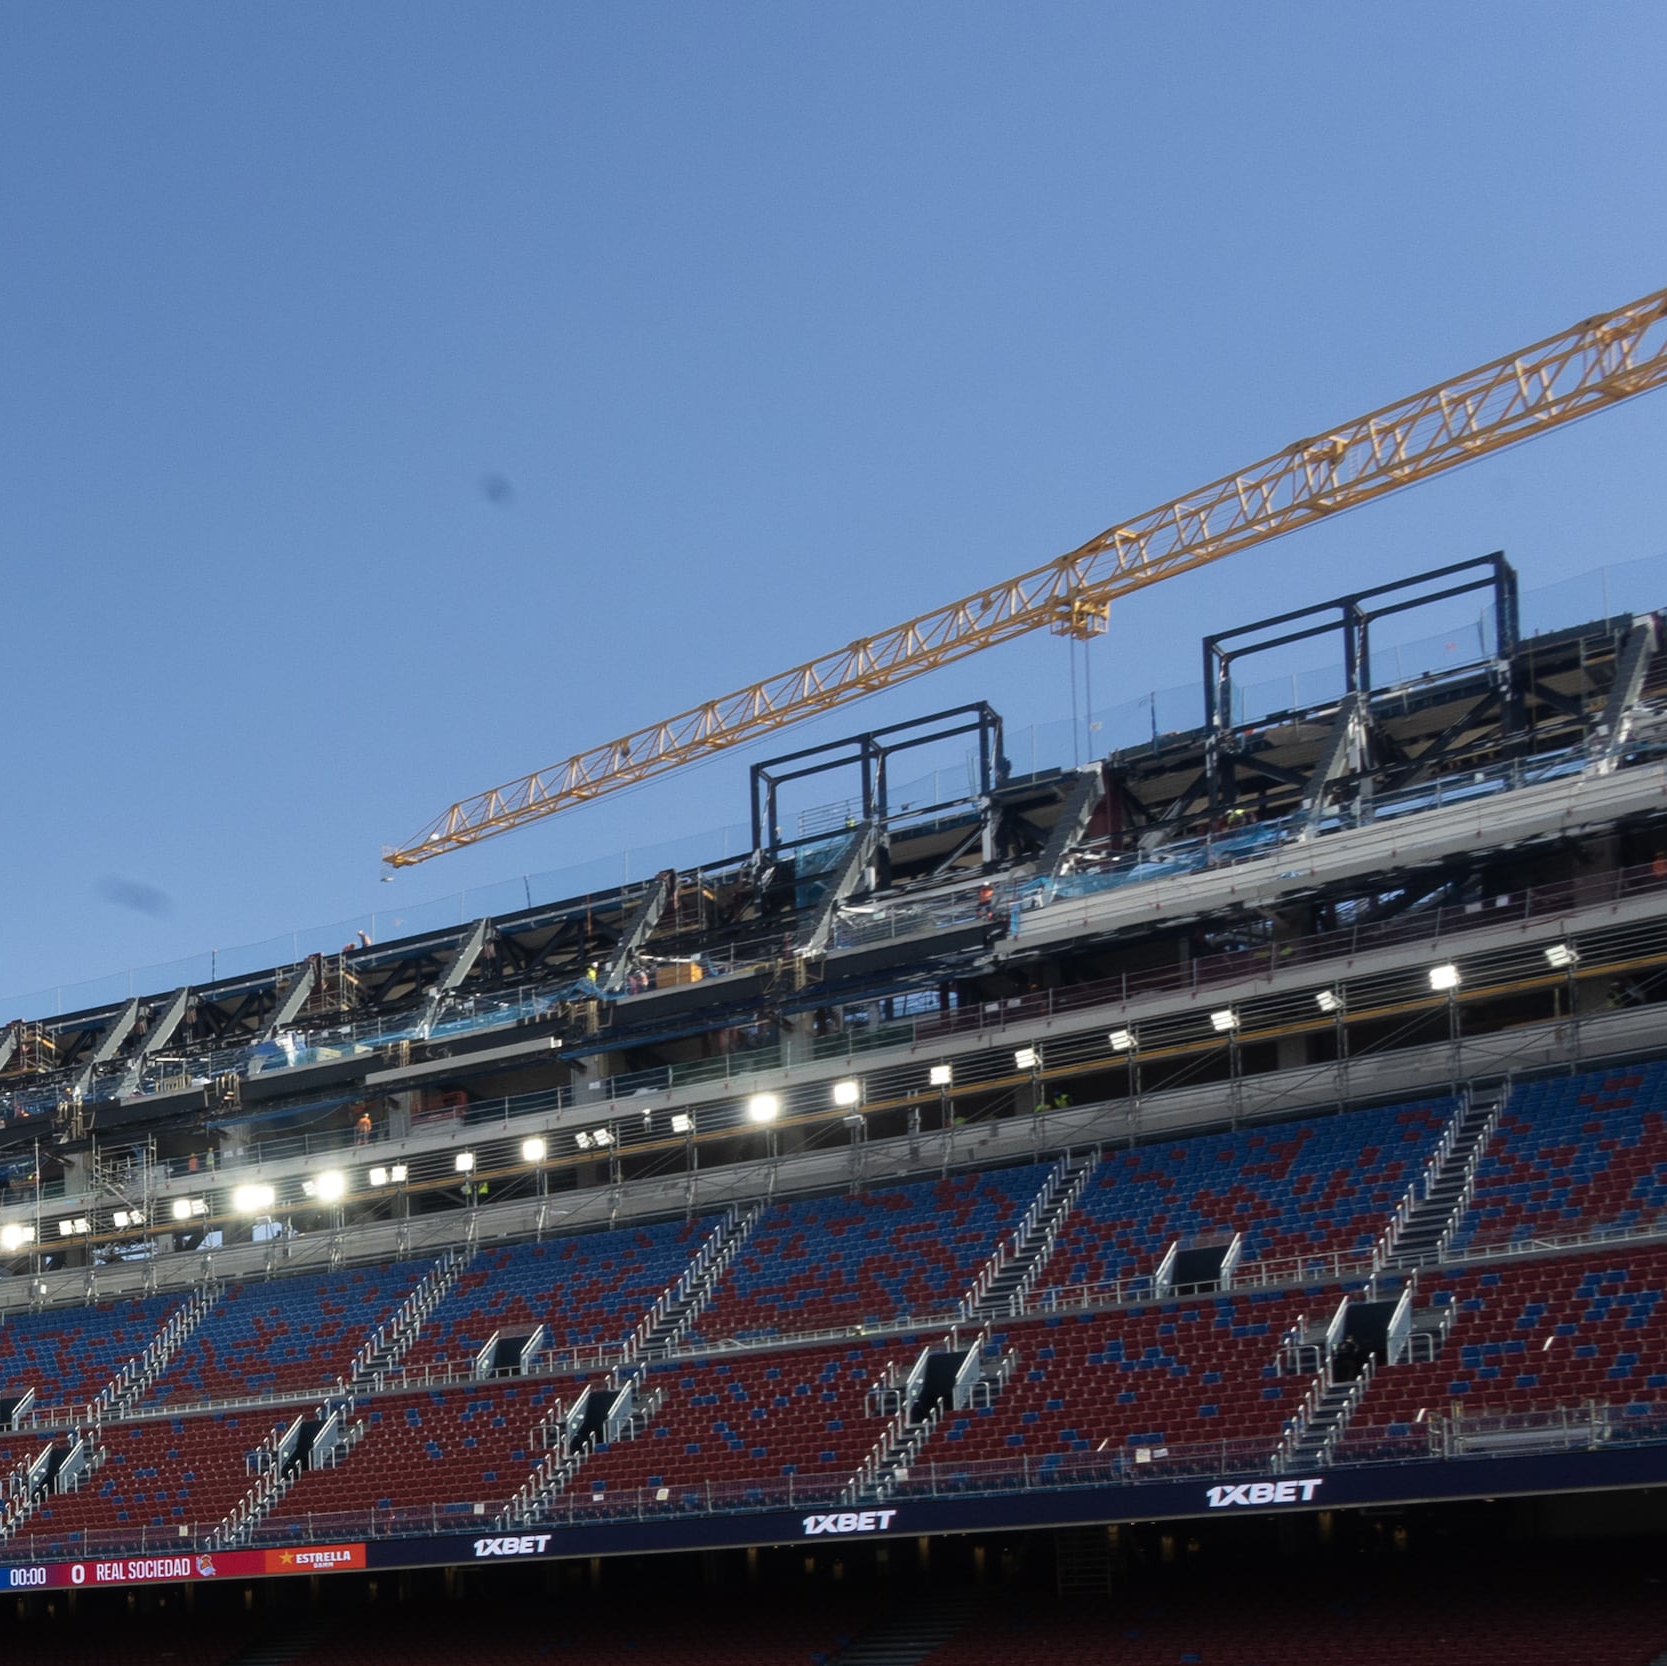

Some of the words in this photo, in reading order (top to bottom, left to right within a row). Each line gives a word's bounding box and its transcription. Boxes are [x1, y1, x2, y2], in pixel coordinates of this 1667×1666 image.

[1206, 1478, 1323, 1508] 1XBET
[802, 1508, 897, 1534] 1XBET
[295, 1551, 351, 1564] ESTRELLA
[474, 1534, 552, 1557] 1XBET
[10, 1567, 46, 1586] 00:00
[71, 1565, 86, 1585] 0
[96, 1562, 126, 1581] REAL
[128, 1558, 191, 1579] SOCIEDAD
